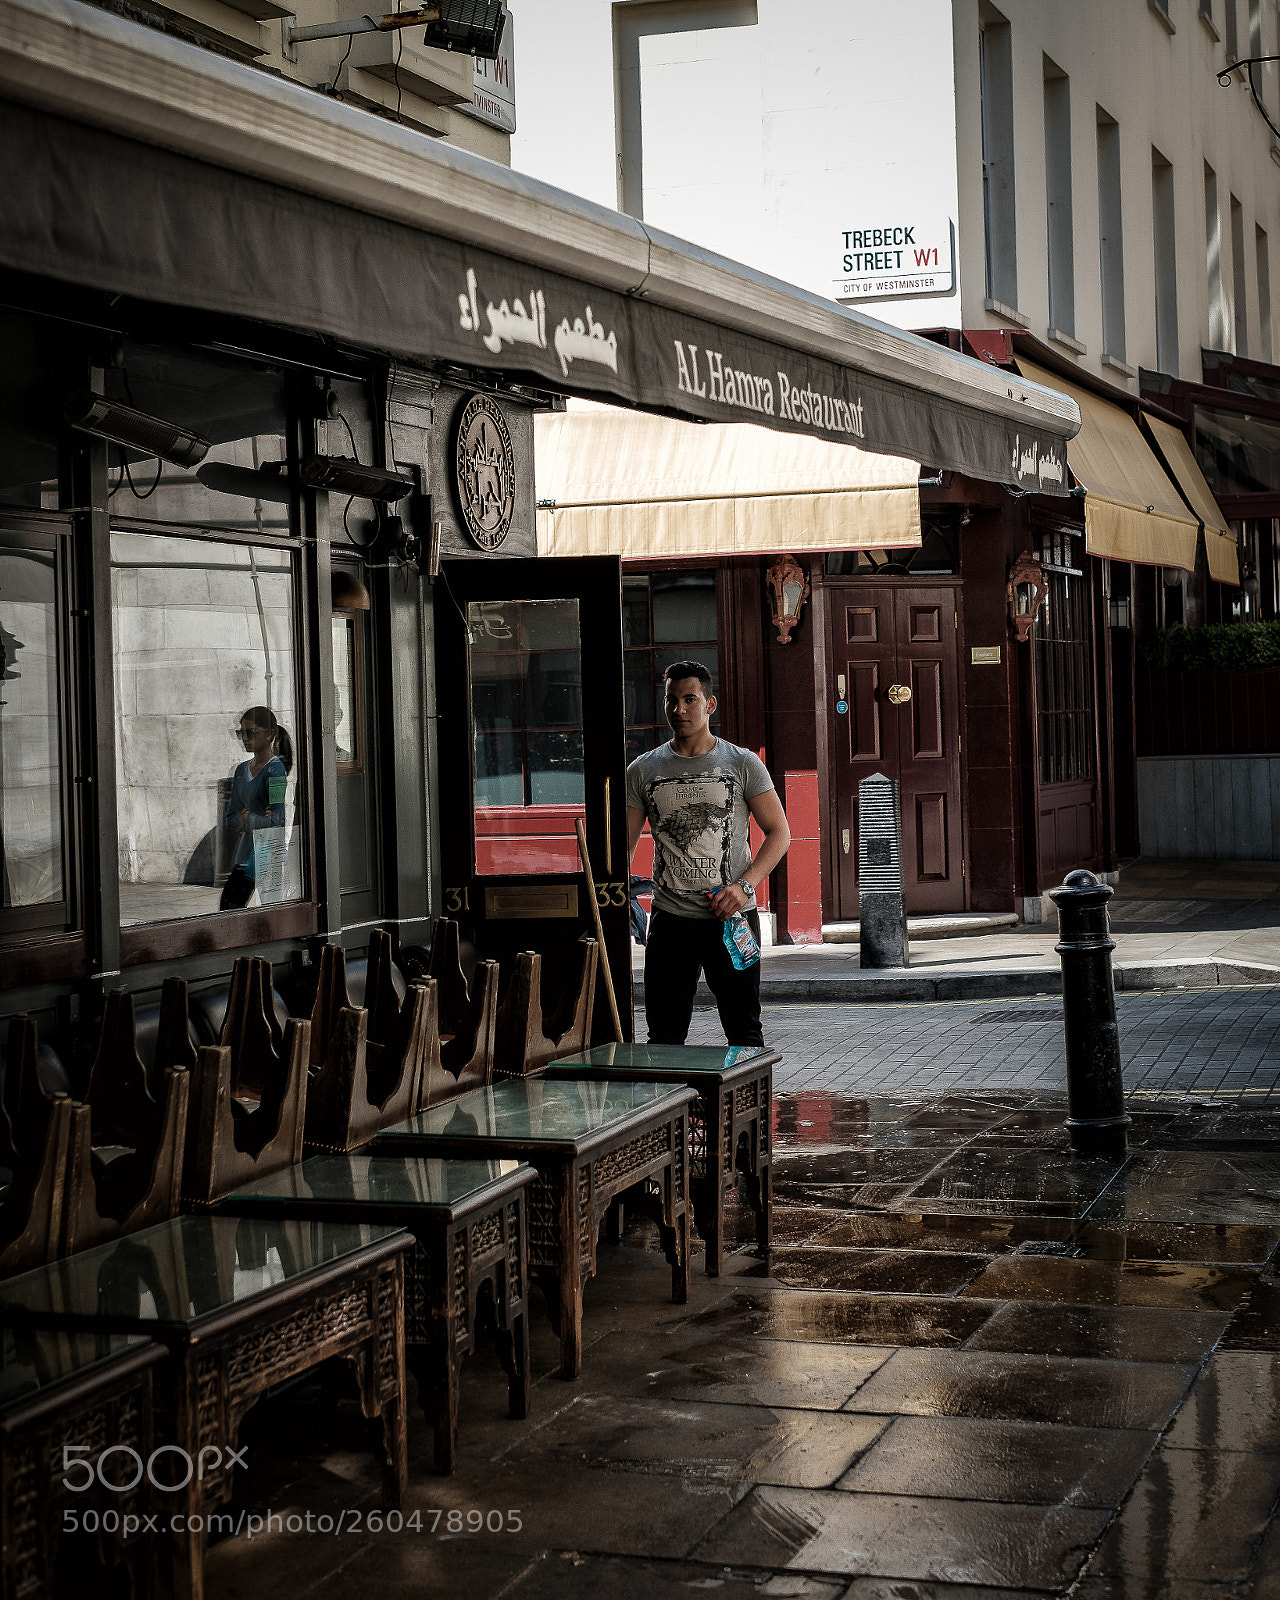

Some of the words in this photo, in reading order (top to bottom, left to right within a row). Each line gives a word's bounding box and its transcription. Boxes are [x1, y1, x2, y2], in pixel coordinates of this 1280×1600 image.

[493, 53, 509, 88] W1
[842, 226, 916, 249] TREBECK
[843, 250, 904, 273] STREET
[913, 247, 938, 267] W1
[843, 282, 861, 294] CITY
[863, 282, 873, 292] OF
[876, 278, 935, 291] WESTMINSTER
[554, 304, 618, 377] مطعم
[674, 339, 706, 399] AL
[705, 349, 775, 417] Hamra
[777, 370, 865, 439] Restaurant
[445, 886, 470, 912] 31
[594, 882, 627, 907] 33
